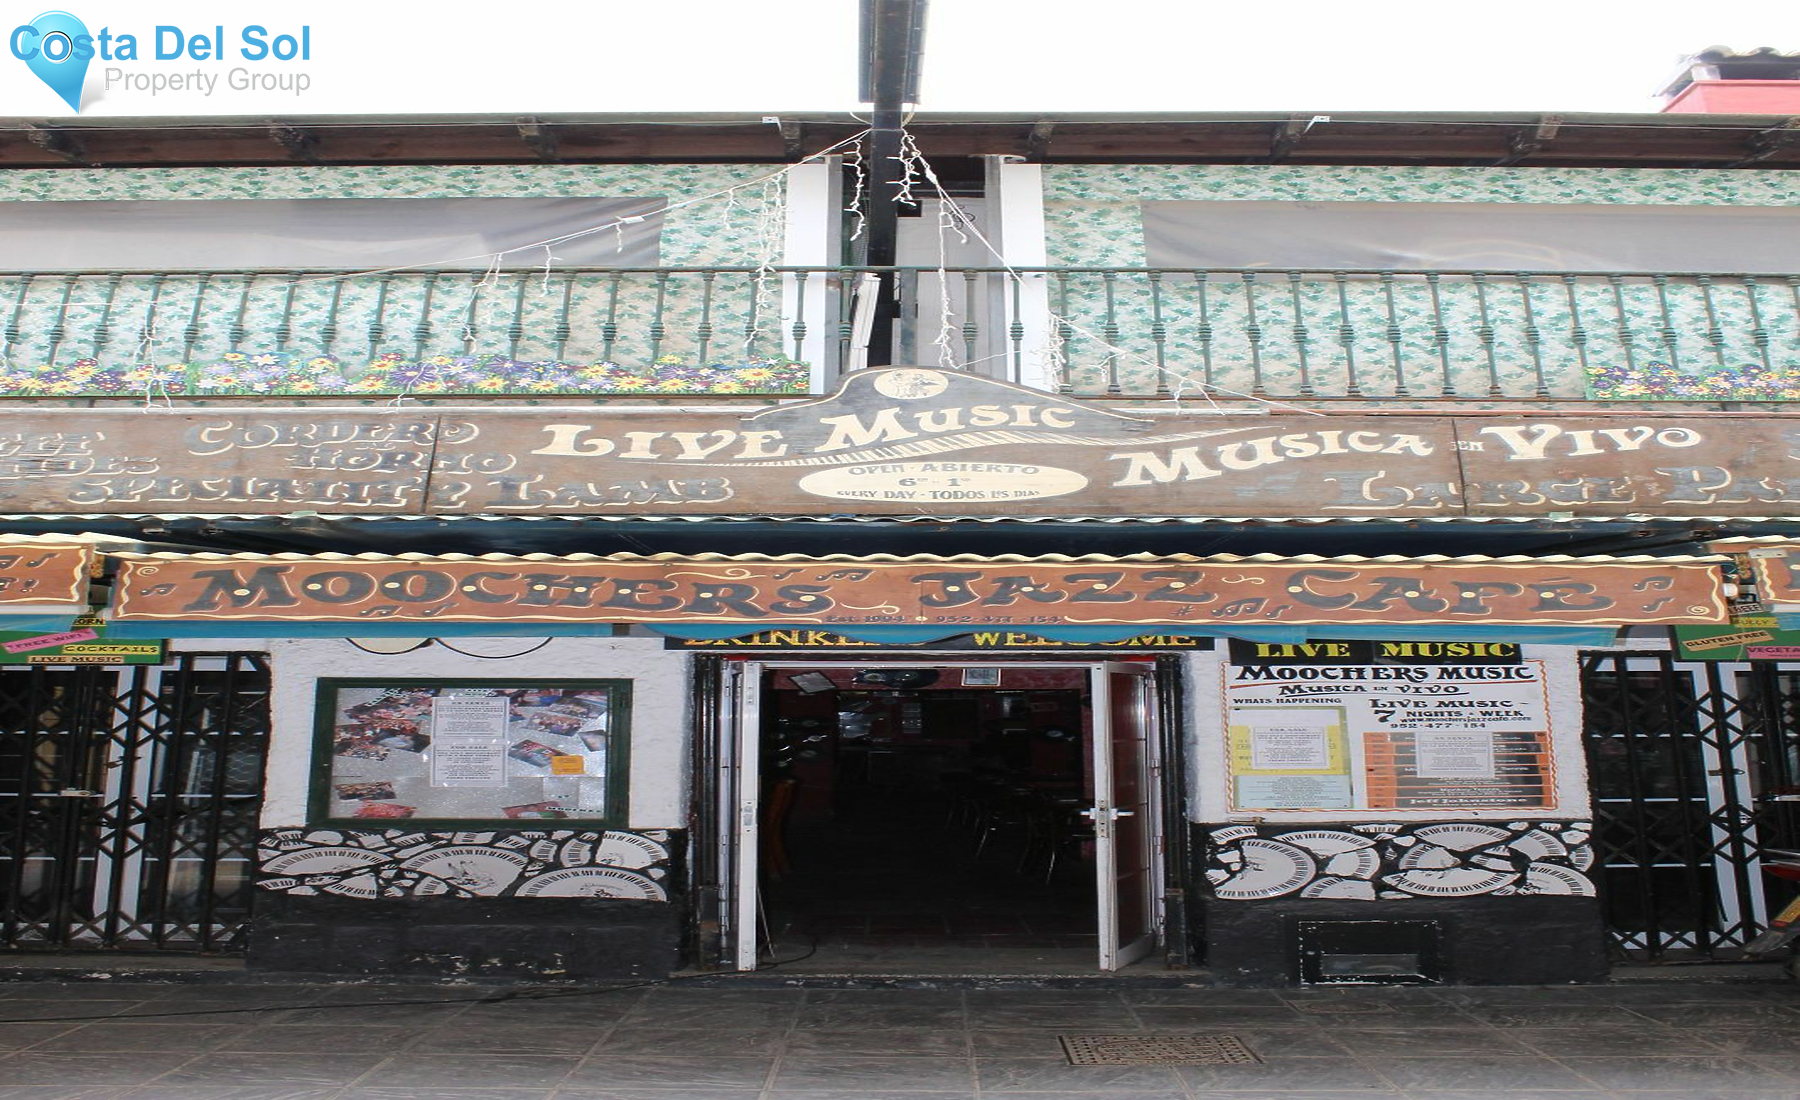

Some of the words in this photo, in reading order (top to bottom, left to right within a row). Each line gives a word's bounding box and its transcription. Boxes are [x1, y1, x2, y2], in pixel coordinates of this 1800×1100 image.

[531, 424, 789, 460] LIVE
[814, 404, 1076, 453] MUSIC
[1109, 430, 1434, 488] MUSICA
[1480, 424, 1702, 460] VIVO
[848, 464, 905, 476] OPEN
[922, 463, 1040, 475] ABIERTO
[884, 490, 917, 499] DAY
[929, 490, 986, 500] TODOS
[183, 566, 835, 617] MOOCHERS
[910, 570, 1219, 608] JAZZ
[1686, 636, 1735, 647] GLUTEN
[1736, 631, 1769, 641] FREE
[64, 645, 158, 653] COCKTAILS
[1255, 643, 1351, 657] LIVE
[1381, 643, 1518, 657] MUSIC
[1235, 666, 1429, 683] MOOCHERS
[1437, 667, 1534, 680] MUSIC
[1278, 684, 1368, 696] MUSICA
[1395, 685, 1460, 694] VIVO
[1369, 699, 1428, 708] LIVE
[1435, 700, 1514, 708] MUSIC
[1374, 709, 1396, 723] 7
